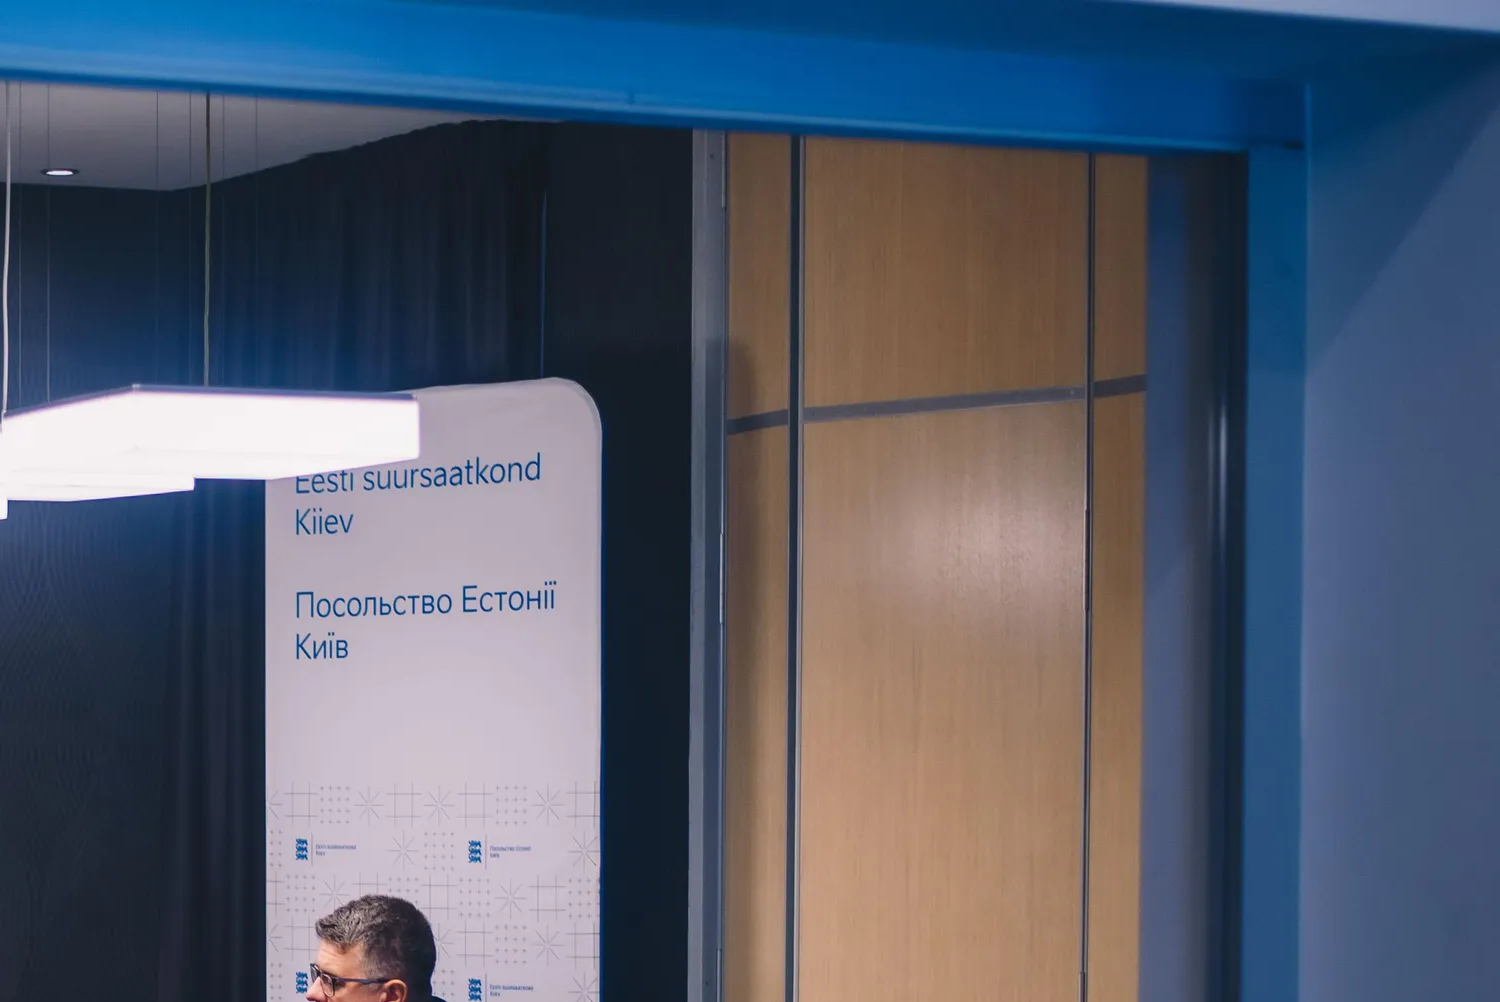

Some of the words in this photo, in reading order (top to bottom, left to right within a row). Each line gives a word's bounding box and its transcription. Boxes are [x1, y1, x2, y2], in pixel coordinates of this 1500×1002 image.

[363, 452, 541, 491] suursaatkond
[295, 508, 354, 535] Kiiev
[296, 591, 452, 618] Посольство
[462, 581, 557, 613] Естонії
[295, 632, 349, 659] Київ
